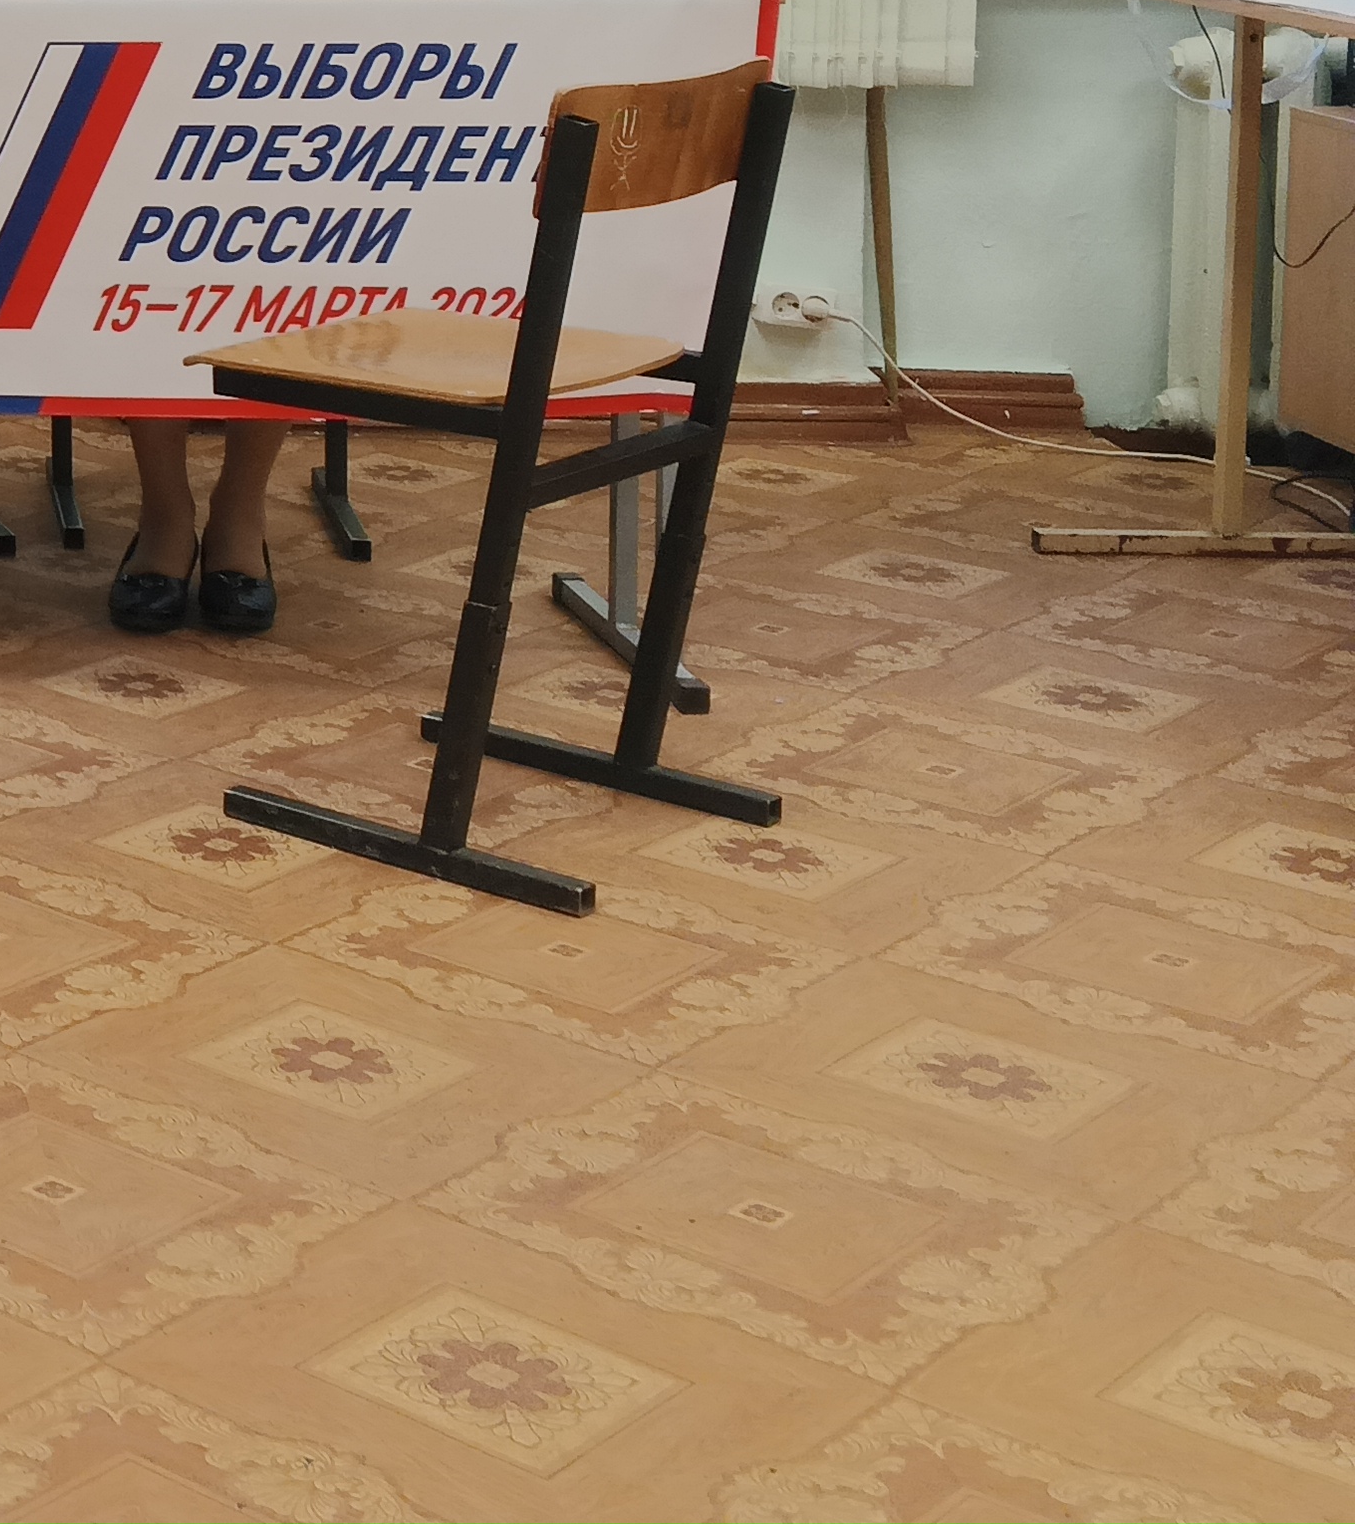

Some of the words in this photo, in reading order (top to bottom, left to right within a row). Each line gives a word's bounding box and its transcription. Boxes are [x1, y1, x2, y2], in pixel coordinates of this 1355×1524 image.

[192, 42, 518, 100] ВЫБОРЫ
[155, 124, 548, 192] ПРЕЗИДЕН
[118, 206, 412, 263] РОССИИ
